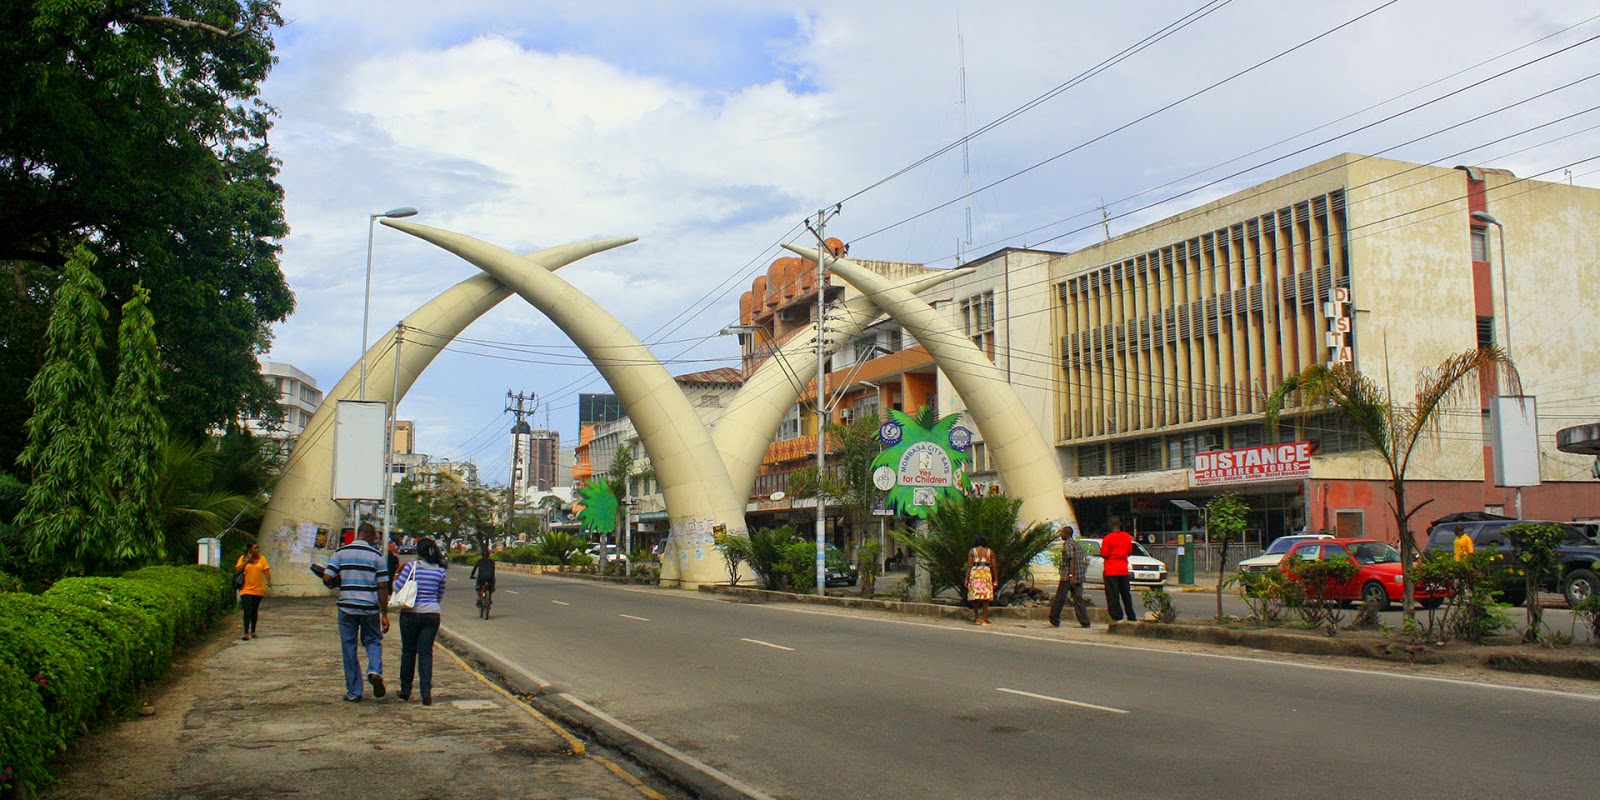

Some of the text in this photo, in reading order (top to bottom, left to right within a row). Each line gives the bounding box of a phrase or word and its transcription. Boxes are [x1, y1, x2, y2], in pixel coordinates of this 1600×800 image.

[1331, 288, 1348, 366] DISTA
[901, 445, 926, 473] MOMBASA
[941, 456, 950, 474] SAYS
[1195, 443, 1310, 471] DISTANCE
[903, 475, 947, 484] for Children
[919, 469, 932, 477] Yes
[1204, 462, 1300, 479] CAR HIRE & TOURS
